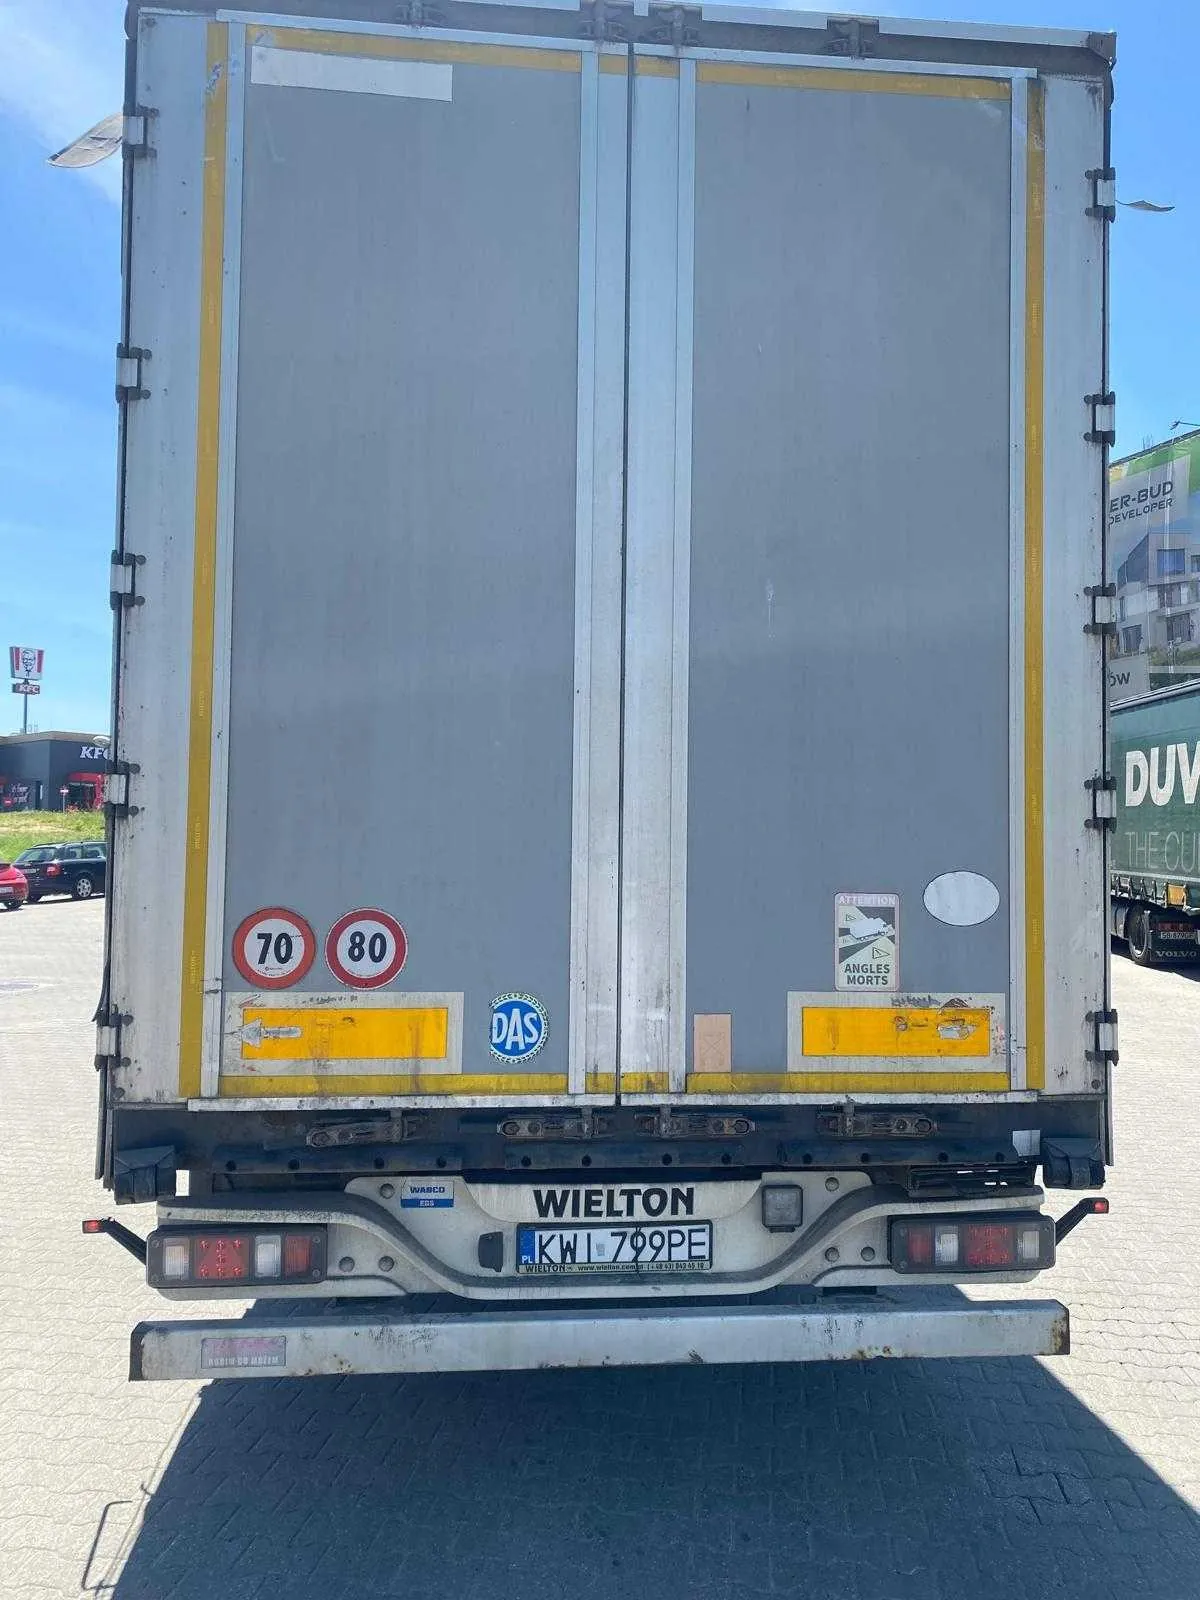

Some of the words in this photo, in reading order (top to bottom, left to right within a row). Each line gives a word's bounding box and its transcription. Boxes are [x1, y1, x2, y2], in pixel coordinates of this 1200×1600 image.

[18, 684, 39, 694] KFC
[1125, 740, 1200, 807] DUV
[1124, 831, 1160, 869] THE
[1164, 831, 1200, 872] CU
[256, 932, 293, 965] 70
[347, 931, 387, 963] 80
[1156, 950, 1197, 958] VOLVO
[844, 963, 890, 974] ANGLES
[847, 975, 889, 986] MORTS
[491, 1008, 539, 1051] DAS
[409, 1186, 446, 1194] WABCO
[532, 1187, 695, 1218] WIELTON
[538, 1232, 592, 1264] KWI
[610, 1228, 706, 1263] 799PE
[521, 1255, 534, 1264] PL
[525, 1264, 566, 1273] WIELTON
[577, 1263, 644, 1272] www.wielton.compl
